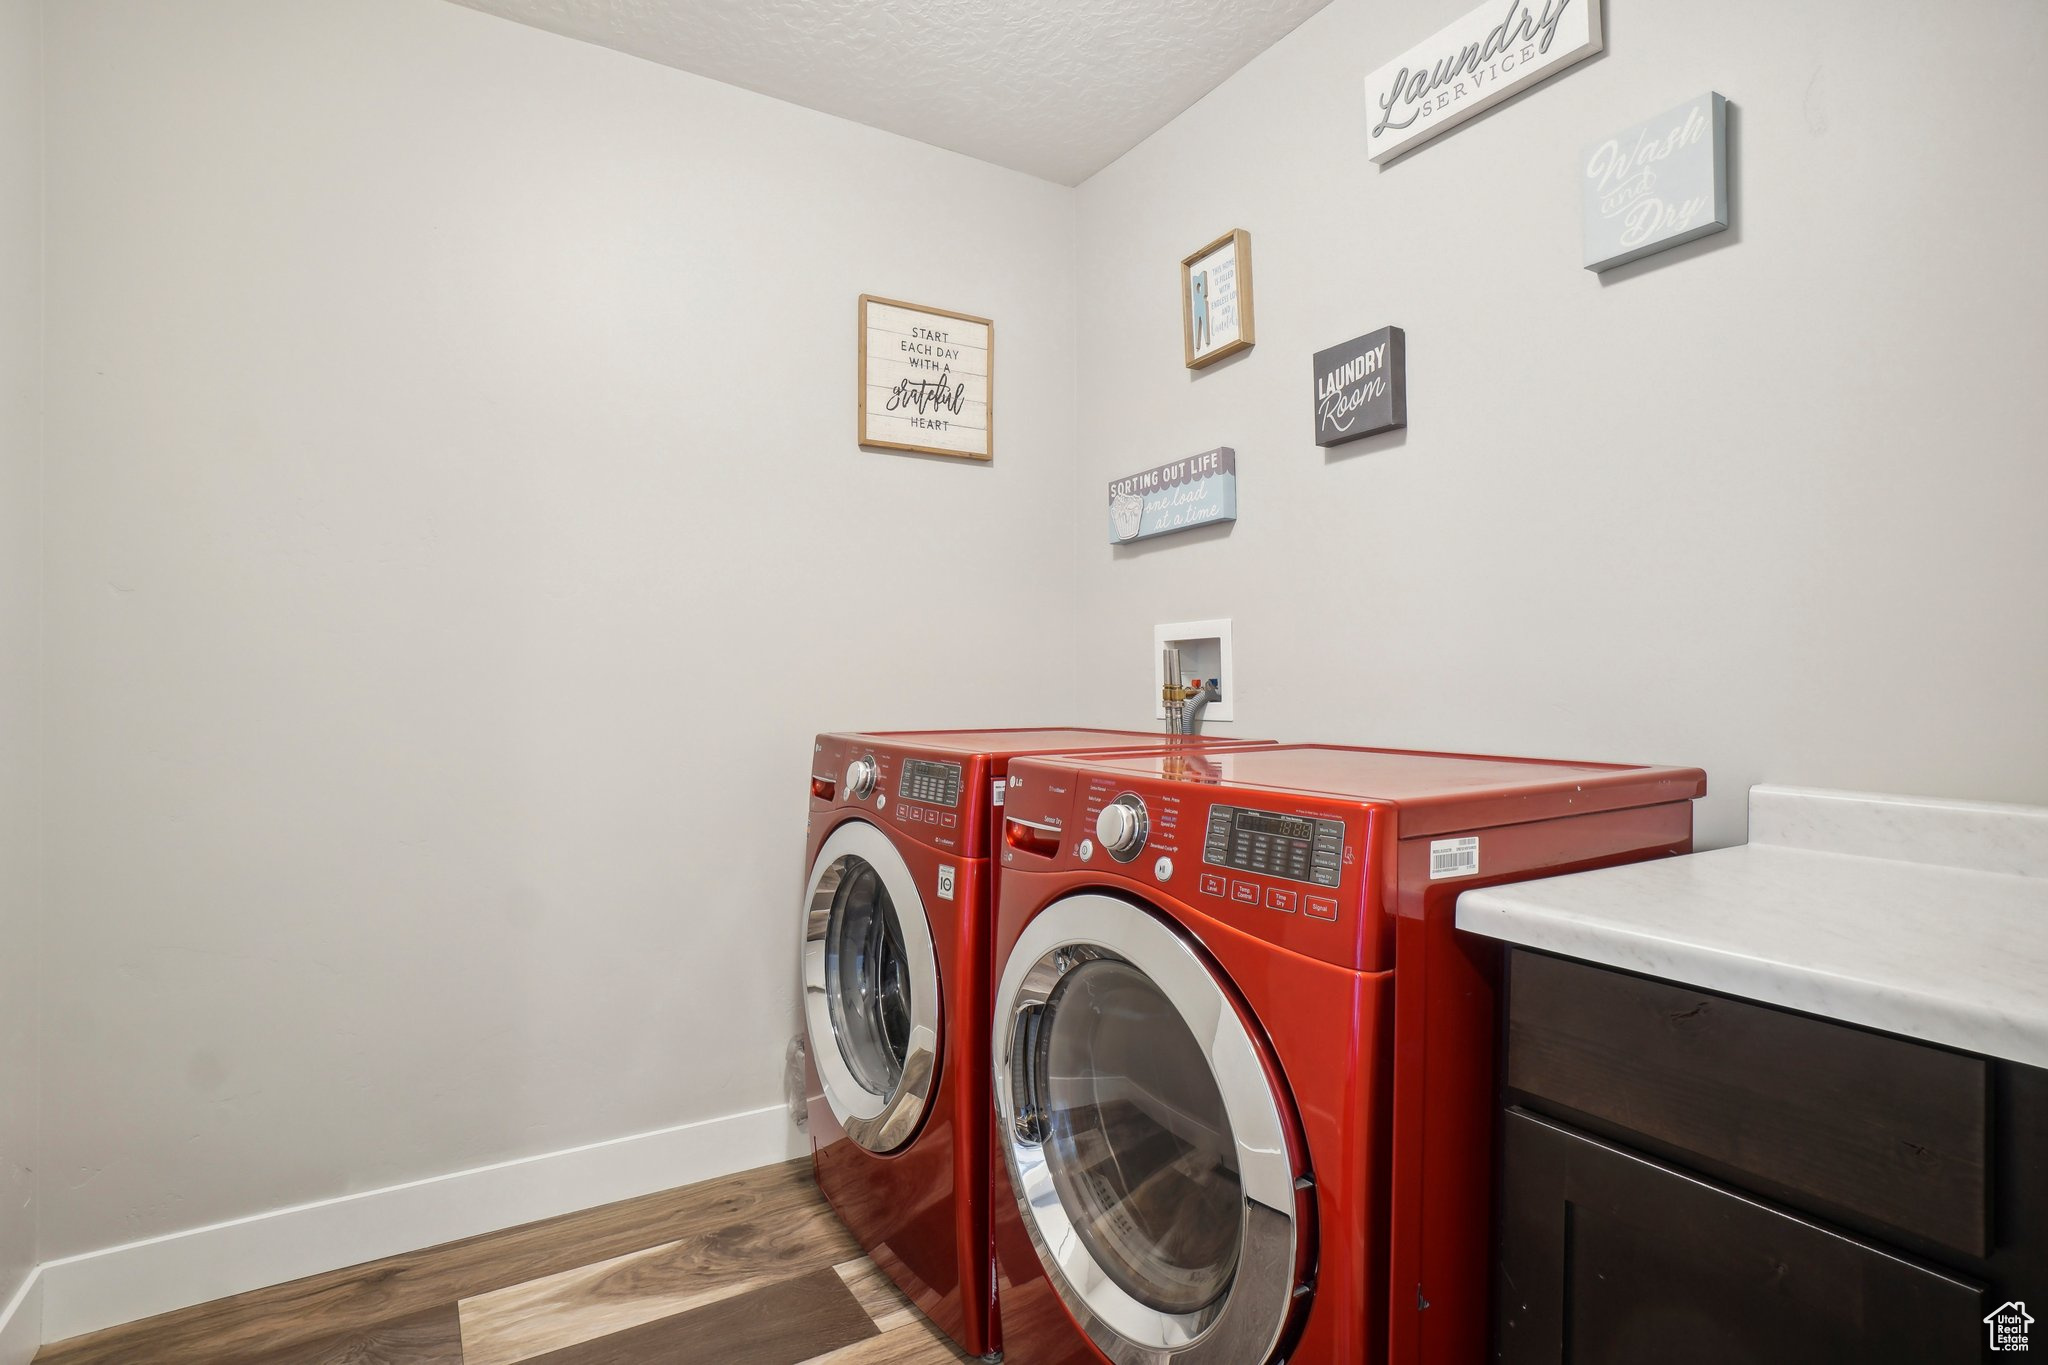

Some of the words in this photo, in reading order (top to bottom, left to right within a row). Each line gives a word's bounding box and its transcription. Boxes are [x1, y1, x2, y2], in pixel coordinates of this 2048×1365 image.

[1372, 0, 1570, 138] Laundry
[1422, 43, 1535, 118] SERVICE
[1587, 106, 1709, 191] Wash
[1601, 165, 1655, 214] and
[1620, 196, 1708, 246] Dry
[901, 341, 932, 356] EACH
[936, 346, 959, 360] DAY
[912, 327, 948, 343] START
[909, 357, 939, 372] WITH
[943, 363, 951, 373] A
[1318, 342, 1385, 400] LAUNDRY
[886, 373, 964, 415] grateful
[1318, 376, 1386, 431] Room
[911, 417, 949, 431] HEART
[1110, 471, 1159, 498] SORTING
[1163, 462, 1185, 481] OUT
[1191, 452, 1218, 474] LIFE
[1144, 498, 1171, 514] one
[1170, 480, 1208, 506] load
[1154, 510, 1171, 531] at
[1173, 515, 1183, 525] a
[1183, 503, 1219, 525] time
[1016, 778, 1023, 787] LG
[1044, 815, 1056, 823] Sensor
[940, 877, 952, 891] 10
[1276, 893, 1286, 901] Time
[1312, 903, 1328, 912] Signal
